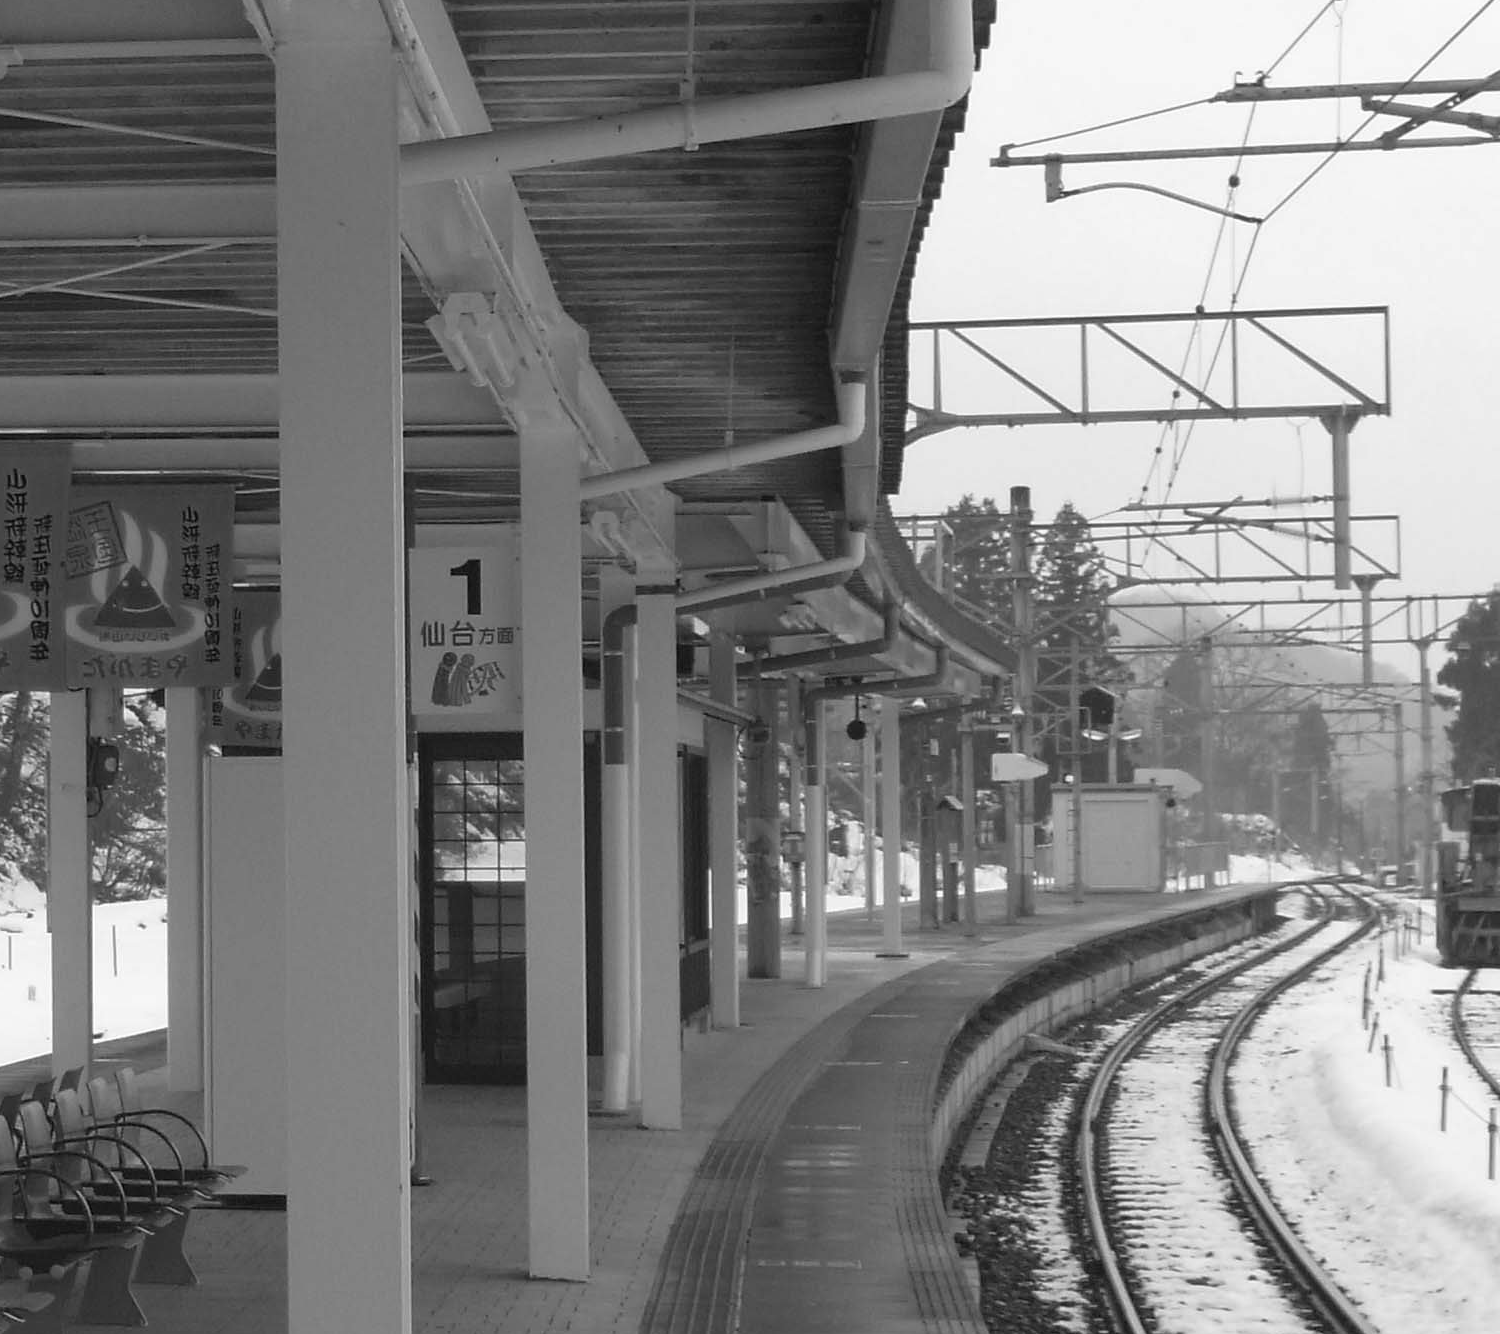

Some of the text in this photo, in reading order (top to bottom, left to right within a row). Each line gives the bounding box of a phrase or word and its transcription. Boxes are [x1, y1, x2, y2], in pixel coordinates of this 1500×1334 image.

[450, 559, 481, 615] 1
[420, 620, 514, 648] 仙台方面
